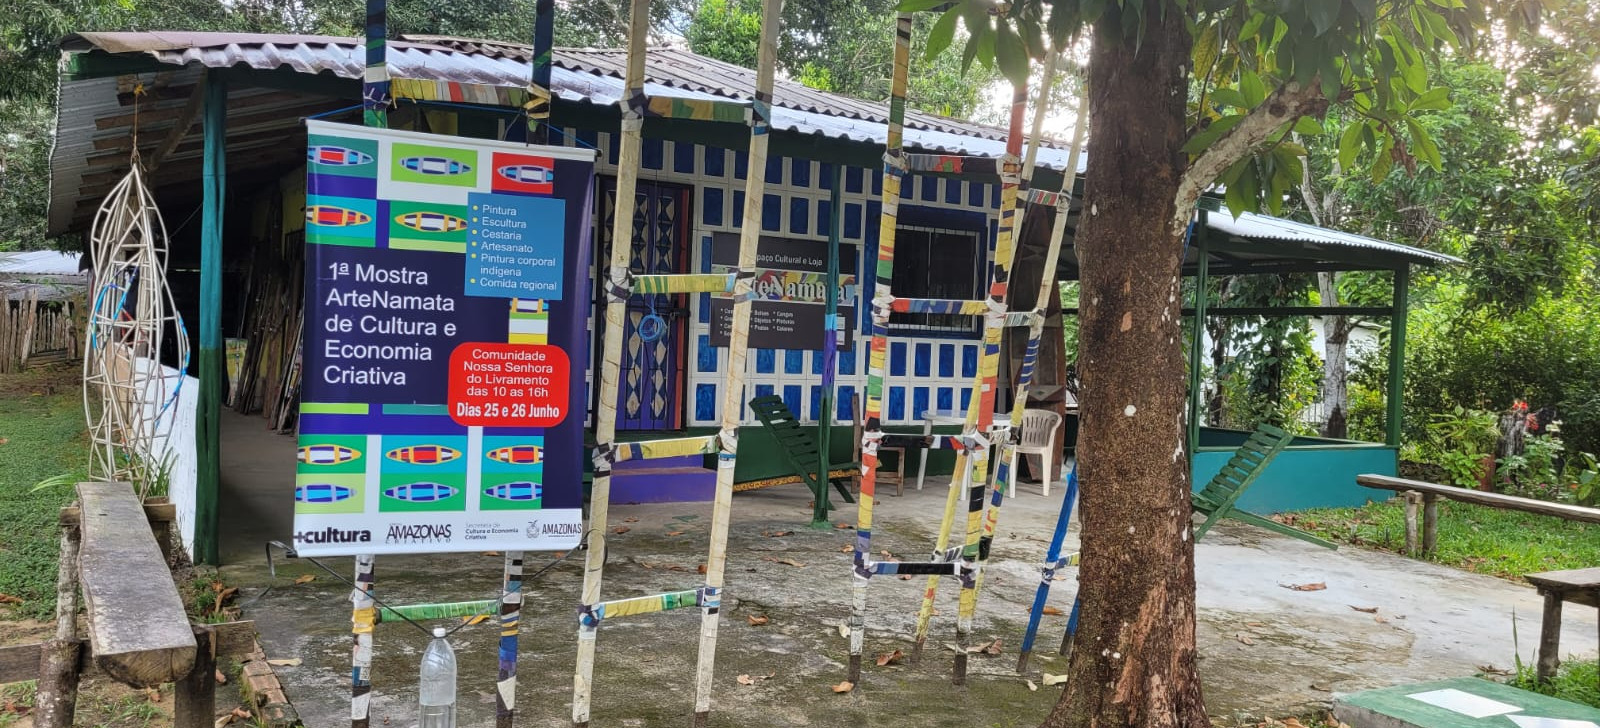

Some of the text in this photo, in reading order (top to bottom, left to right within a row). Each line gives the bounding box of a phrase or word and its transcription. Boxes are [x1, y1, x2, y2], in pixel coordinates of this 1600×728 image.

[482, 204, 516, 216] Pintura
[482, 217, 526, 228] Escultura
[481, 229, 522, 240] Cestaria
[480, 242, 533, 252] Artesanato
[480, 254, 556, 267] Pintura corporal
[774, 254, 801, 264] Cultural
[808, 258, 822, 267] Loja
[329, 262, 428, 285] 1ª Mostra
[480, 277, 557, 291] Comida regional
[325, 288, 454, 311] ArteNamata
[325, 314, 456, 336] de Cultura e
[324, 340, 432, 360] Economia
[472, 349, 546, 361] Comunidade
[464, 361, 553, 373] Nossa Senhora
[324, 365, 406, 385] Criativa
[466, 374, 549, 385] do Livramento
[467, 386, 548, 397] das 10 as 16h
[457, 402, 560, 418] Dias 25 e 26 Junho
[386, 524, 452, 540] AMAZONAS
[542, 523, 582, 535] AMAZONAS
